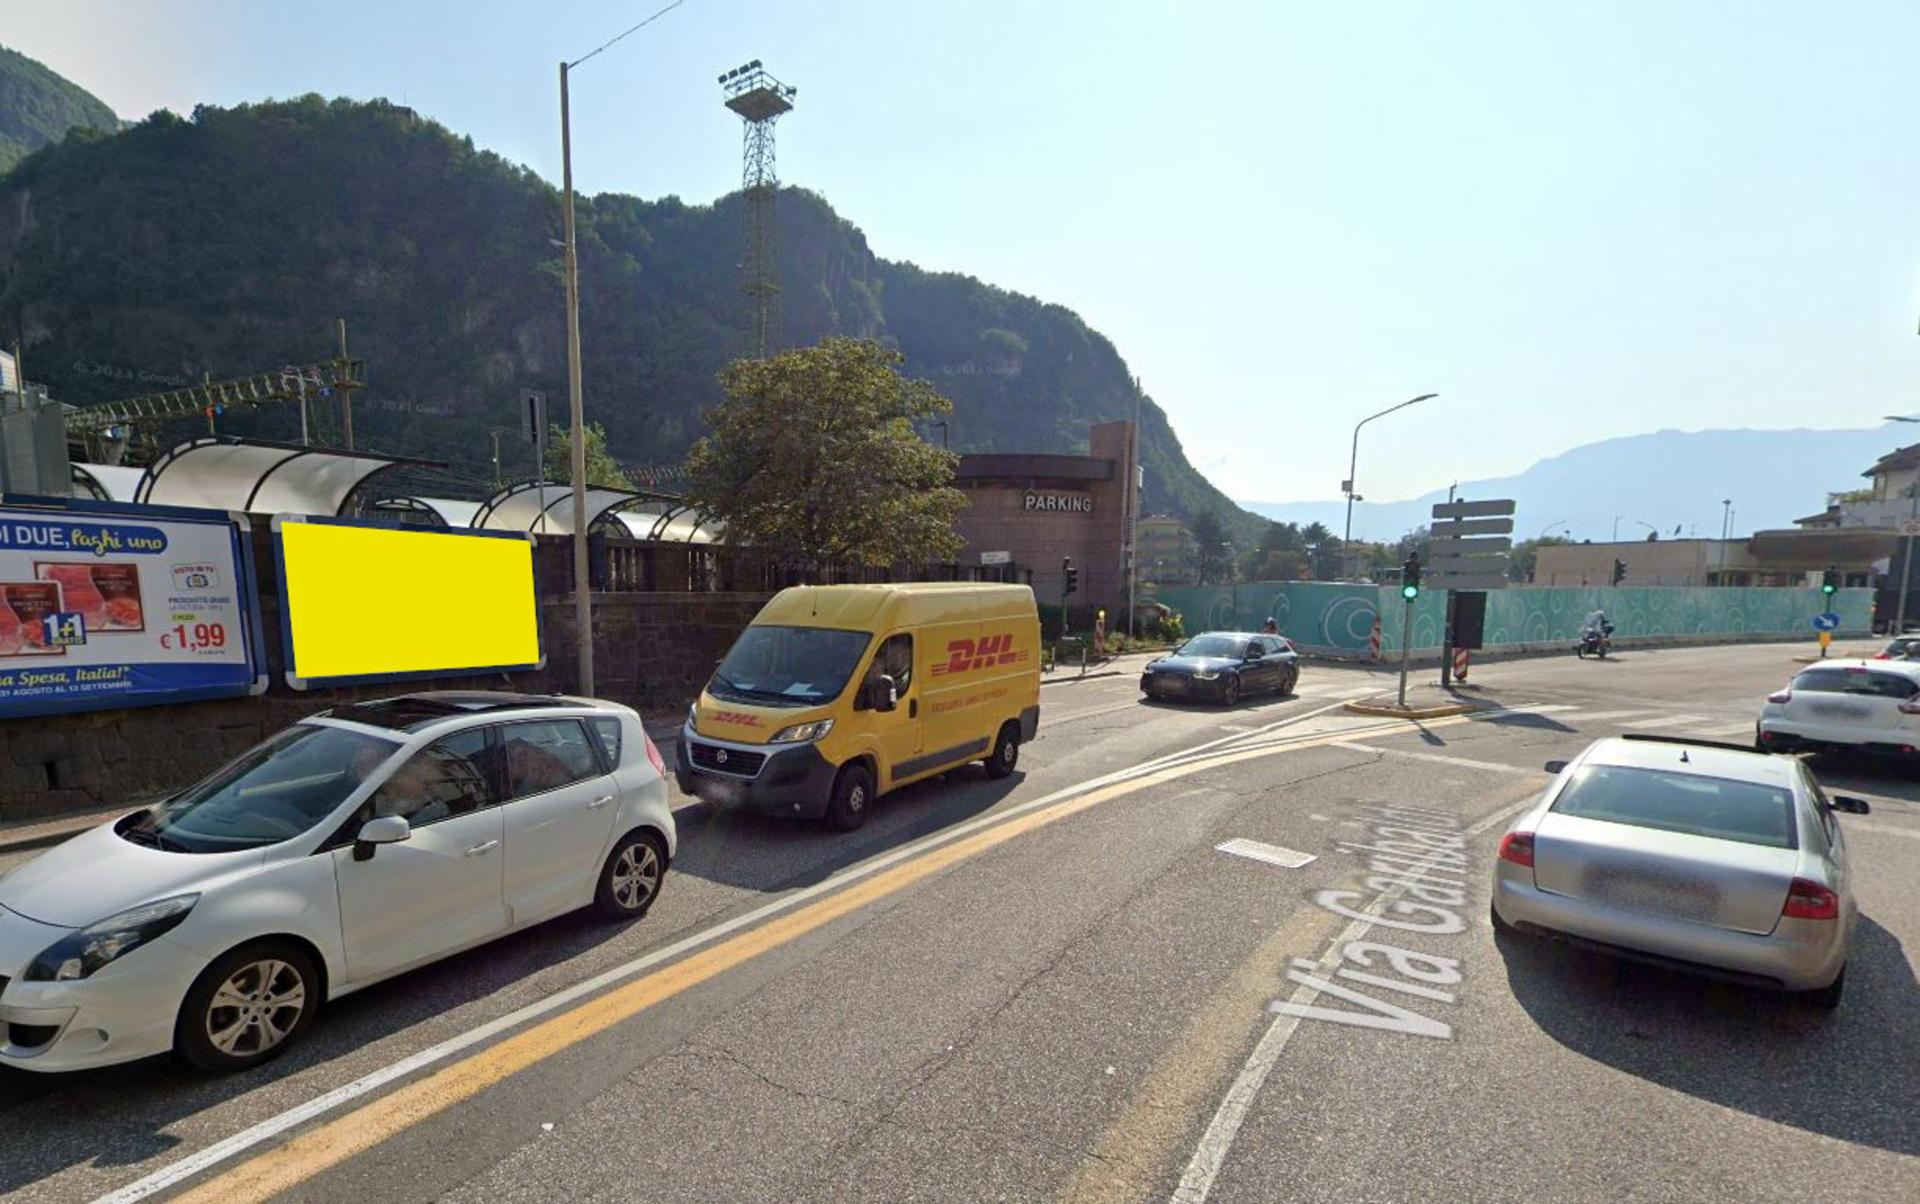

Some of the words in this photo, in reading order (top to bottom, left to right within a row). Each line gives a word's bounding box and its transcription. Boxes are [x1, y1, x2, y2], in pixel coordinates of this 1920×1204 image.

[1025, 495, 1092, 512] PARKING
[15, 525, 70, 548] DUE,
[127, 536, 162, 549] uno
[946, 633, 1014, 674] DHL
[19, 671, 71, 687] Spesa,
[713, 710, 758, 727] DHL
[1268, 940, 1463, 1039] Via
